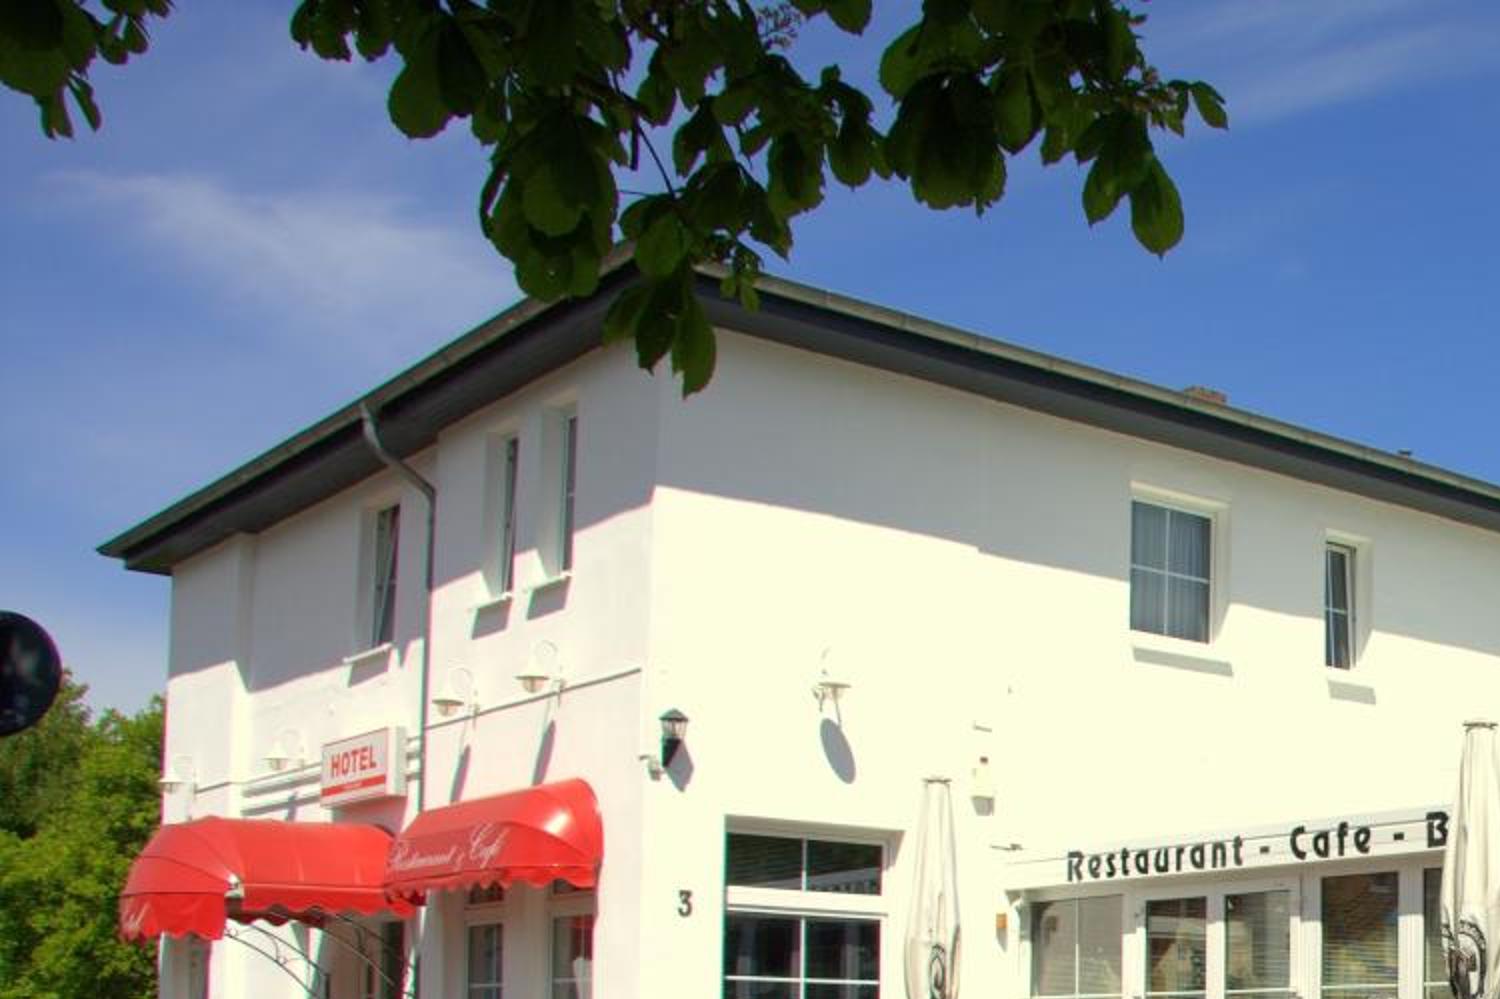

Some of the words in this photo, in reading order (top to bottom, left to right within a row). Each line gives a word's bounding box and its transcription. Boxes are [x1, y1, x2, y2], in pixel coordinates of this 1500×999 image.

[331, 743, 377, 779] HOTEL
[1066, 835, 1244, 883] Restaurant
[1289, 821, 1372, 860] Cafe
[678, 889, 693, 918] 3
